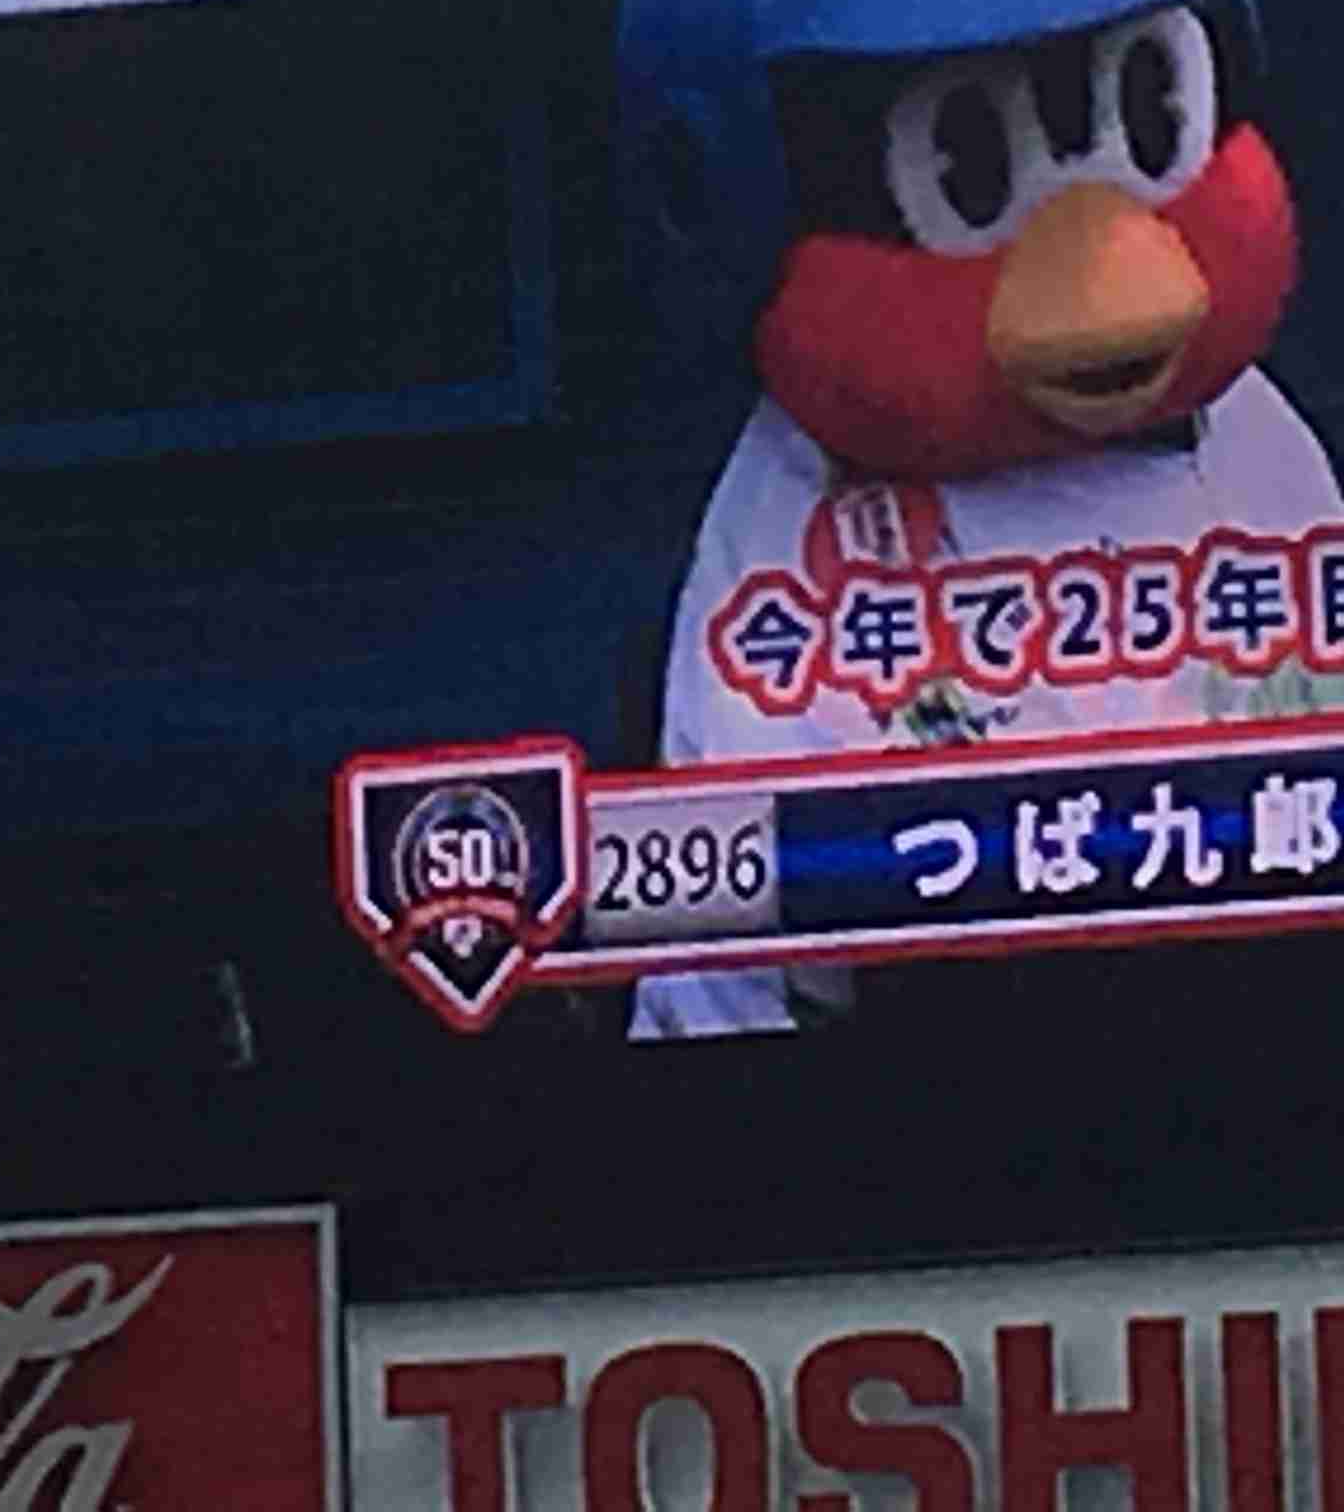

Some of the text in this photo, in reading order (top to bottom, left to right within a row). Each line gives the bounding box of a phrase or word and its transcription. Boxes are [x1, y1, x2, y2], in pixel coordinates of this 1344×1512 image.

[593, 820, 767, 911] 2896
[893, 774, 1341, 897] つば九郎
